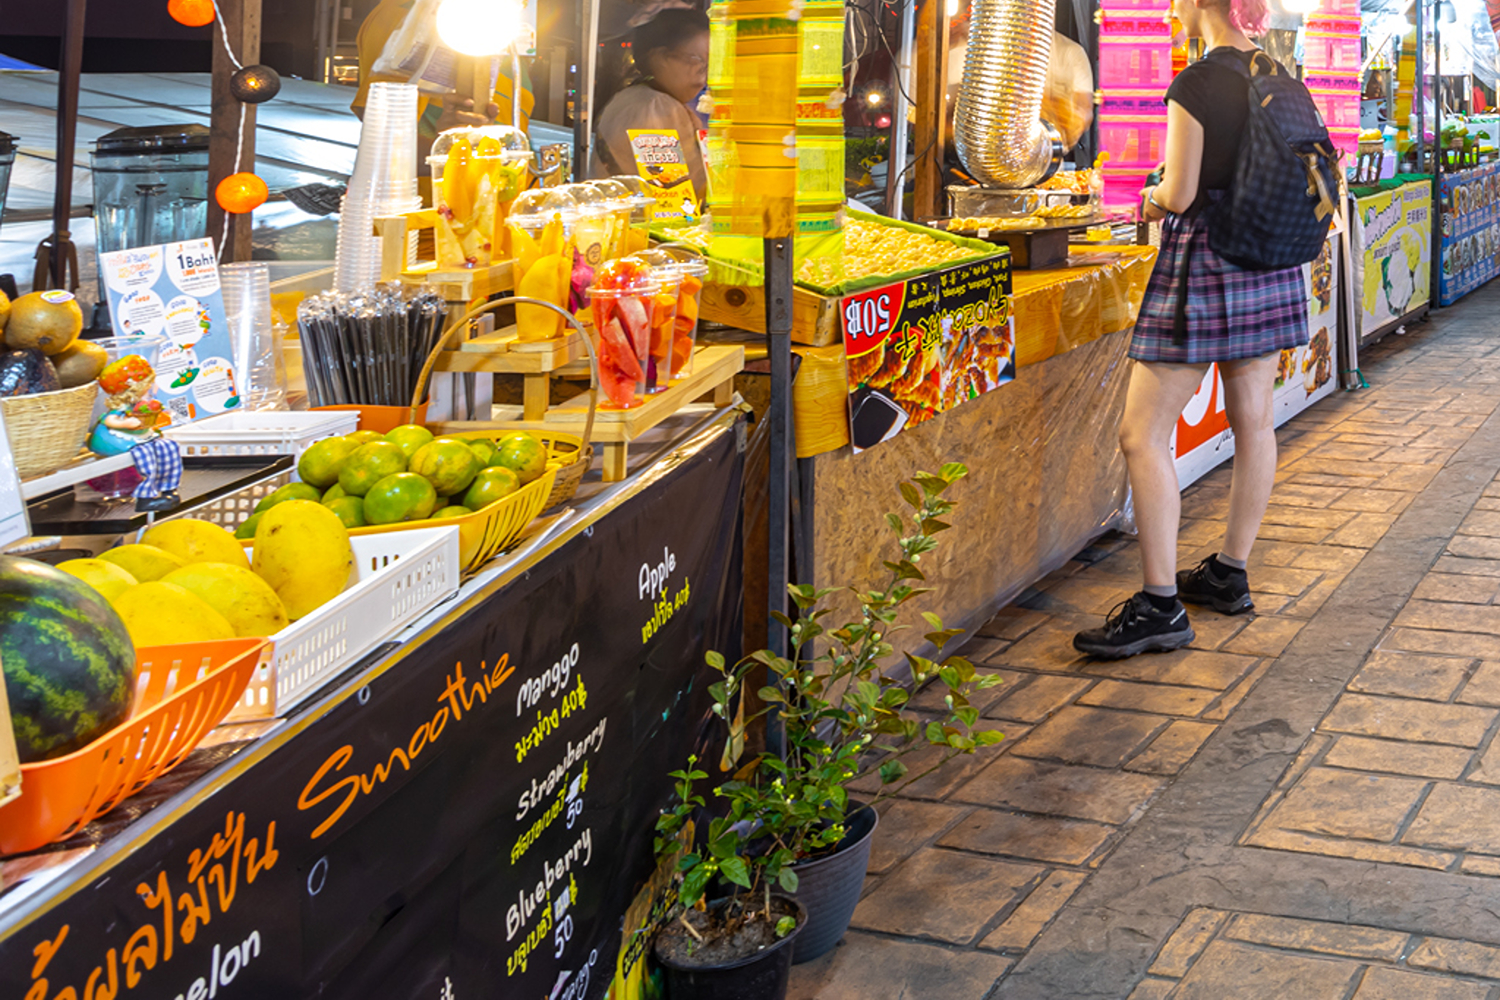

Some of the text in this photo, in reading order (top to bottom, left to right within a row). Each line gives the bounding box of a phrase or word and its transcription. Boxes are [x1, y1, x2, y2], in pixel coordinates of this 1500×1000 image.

[177, 253, 214, 270] 1 Baht
[638, 546, 677, 600] Apple
[516, 642, 580, 717] Manggo
[297, 652, 516, 840] Smoothie
[514, 673, 588, 764] มะม่วง 40฿
[515, 716, 608, 821] Strawberry
[566, 798, 583, 830] 50
[506, 827, 592, 942] Blueberry
[174, 929, 261, 1000] elon
[554, 914, 574, 959] 50
